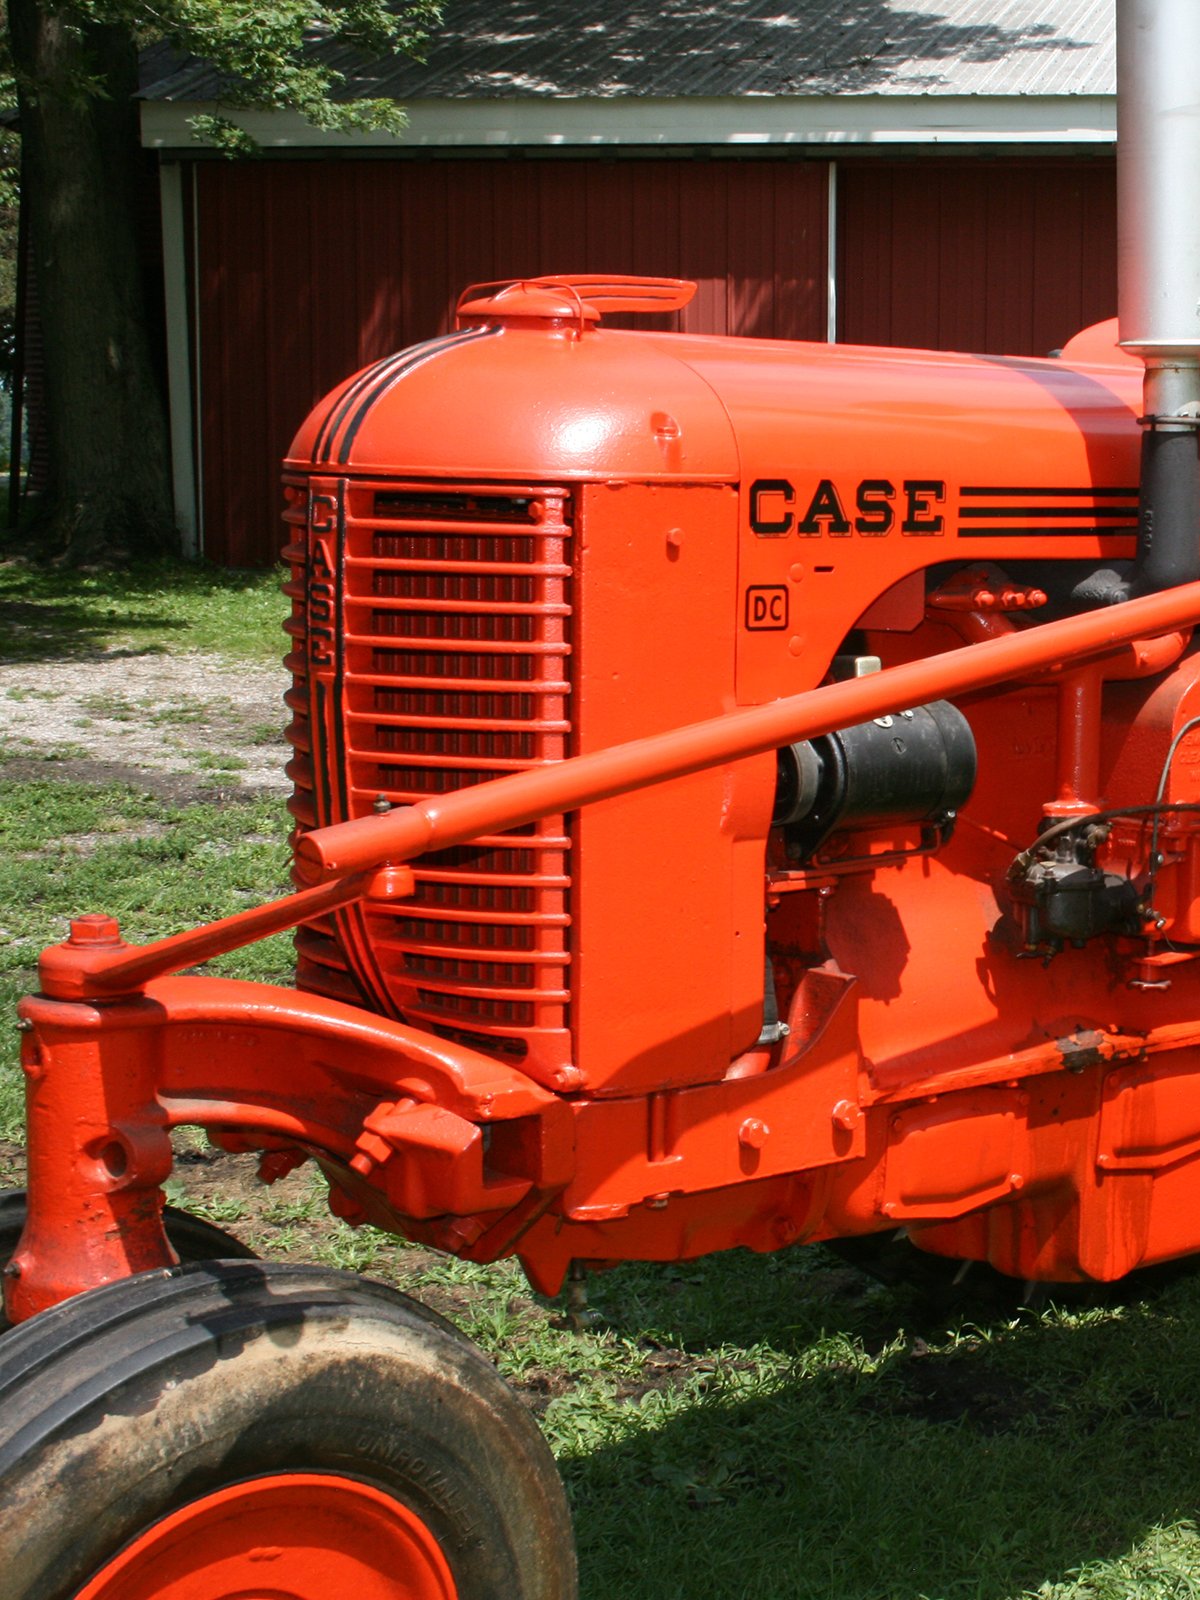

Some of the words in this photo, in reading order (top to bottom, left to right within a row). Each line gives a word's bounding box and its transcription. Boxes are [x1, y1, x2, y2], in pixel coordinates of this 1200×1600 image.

[749, 479, 946, 538] CASE
[310, 494, 338, 667] CASE
[753, 595, 782, 622] DC
